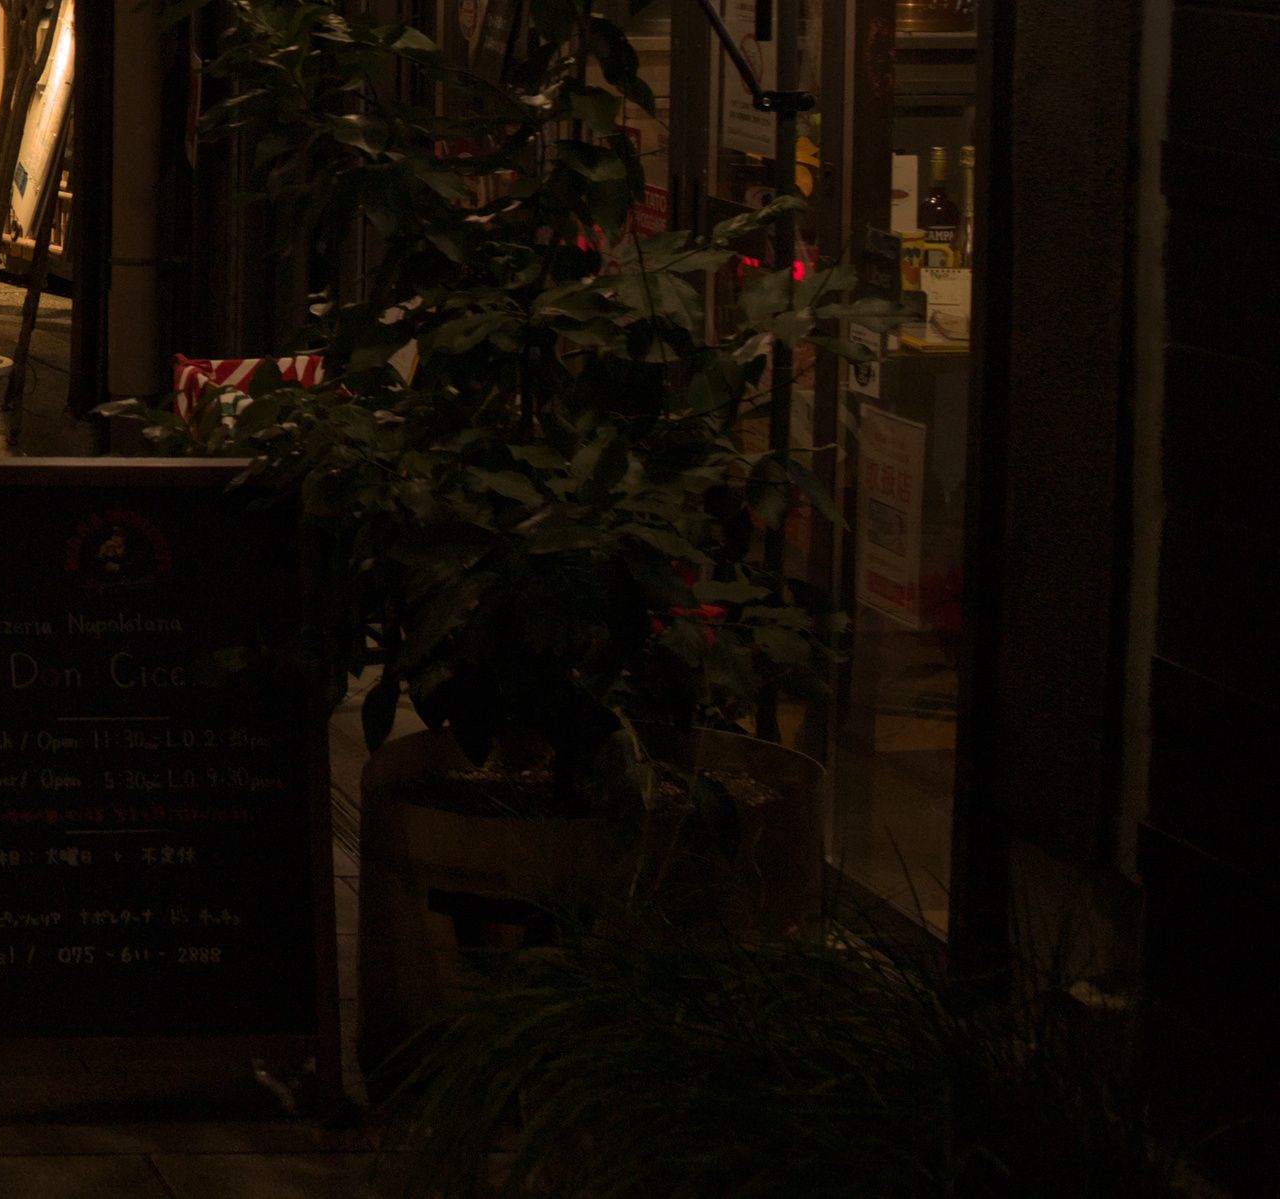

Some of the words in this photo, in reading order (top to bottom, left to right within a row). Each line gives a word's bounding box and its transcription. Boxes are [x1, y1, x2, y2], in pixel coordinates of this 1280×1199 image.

[67, 611, 184, 640] Napoletana
[8, 651, 83, 691] Don
[37, 730, 80, 754] Open
[39, 767, 82, 791] Open
